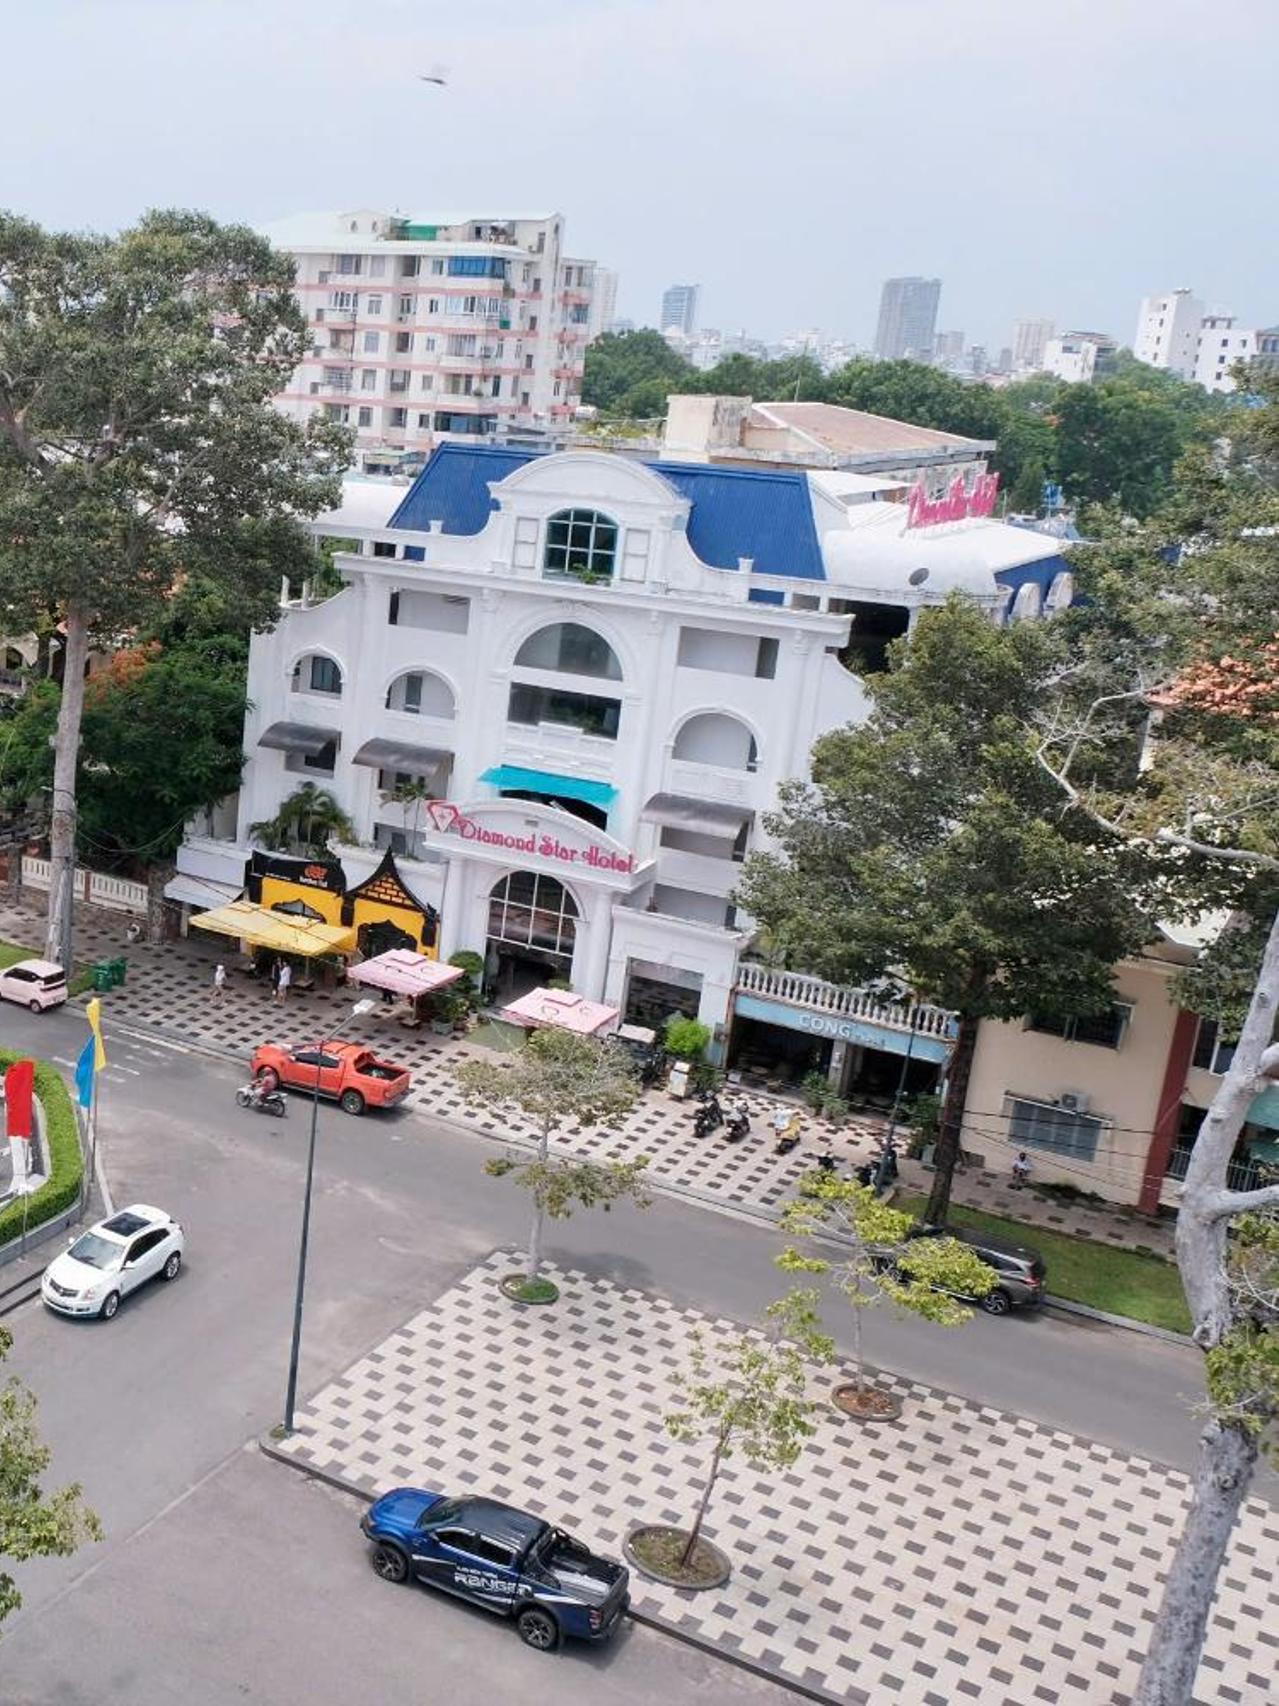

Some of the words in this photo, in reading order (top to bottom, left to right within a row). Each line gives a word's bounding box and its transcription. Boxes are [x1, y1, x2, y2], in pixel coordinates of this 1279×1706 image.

[455, 819, 536, 853] Diamond
[538, 835, 578, 863] Star
[581, 845, 634, 873] Hotel
[454, 1572, 532, 1596] RANGER
